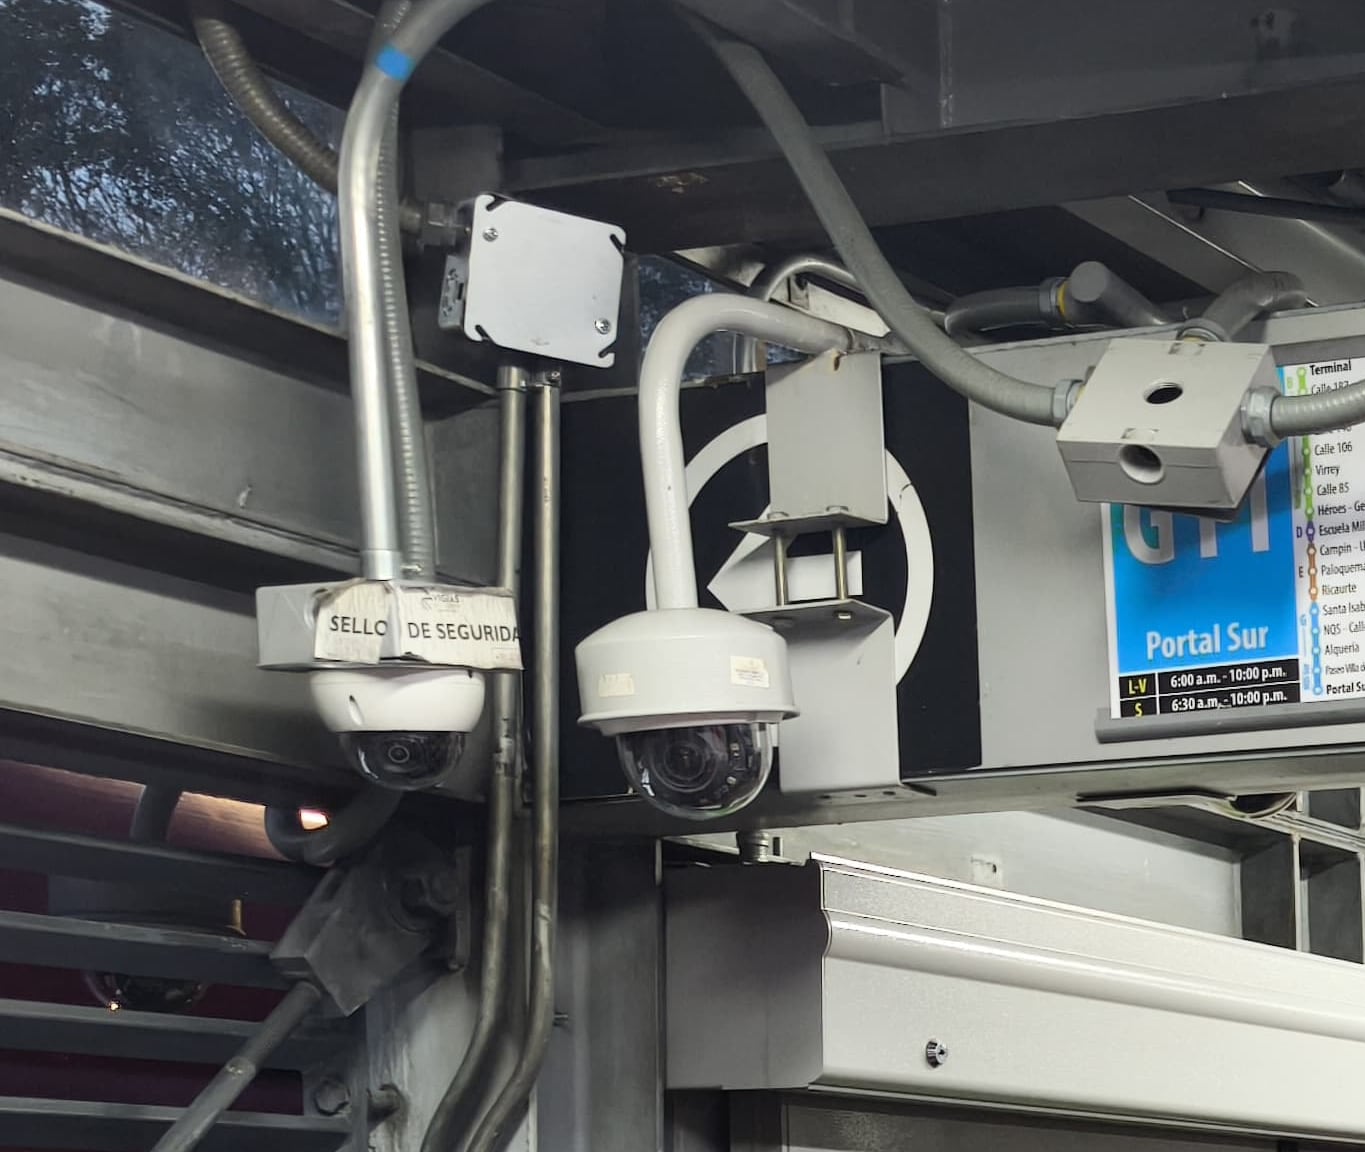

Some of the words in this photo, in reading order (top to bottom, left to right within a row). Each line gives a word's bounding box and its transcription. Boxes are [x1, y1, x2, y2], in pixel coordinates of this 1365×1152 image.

[1310, 360, 1352, 376] Terminal
[1315, 443, 1336, 456] Calle
[1337, 441, 1353, 454] 106
[1315, 464, 1341, 477] Virrey
[1317, 483, 1337, 496] Calle
[1339, 482, 1350, 493] 85
[1296, 526, 1303, 538] D
[1319, 522, 1350, 537] Escuela
[1299, 566, 1304, 578] E
[1322, 583, 1357, 597] Ricaurte
[1322, 604, 1347, 616] Santa
[329, 614, 389, 637] SELLO
[407, 622, 433, 639] DE
[1147, 622, 1221, 661] Portal
[1227, 621, 1269, 653] Sur
[1128, 677, 1148, 695] L-V
[1170, 674, 1195, 689] 6:00
[1196, 672, 1222, 685] a.m.
[1229, 666, 1260, 683] 10:00
[1262, 665, 1287, 682] p.m.
[1326, 682, 1354, 695] Portal
[1134, 702, 1143, 718] S
[1171, 697, 1196, 712] 6:30
[1230, 690, 1261, 707] 10:00
[1262, 690, 1288, 706] p.m.
